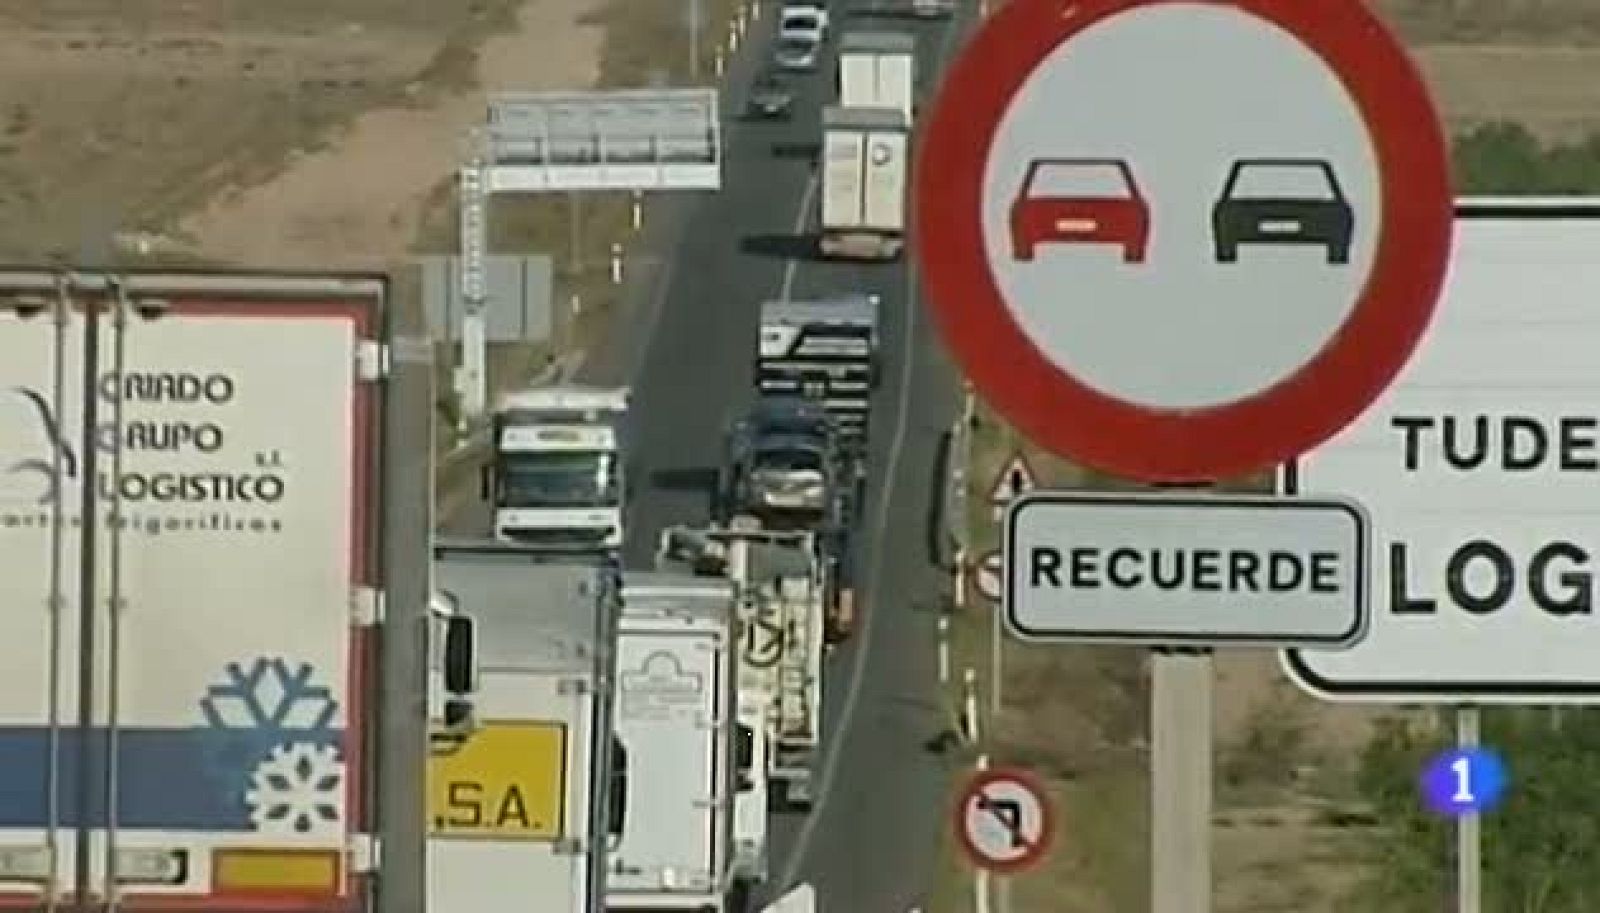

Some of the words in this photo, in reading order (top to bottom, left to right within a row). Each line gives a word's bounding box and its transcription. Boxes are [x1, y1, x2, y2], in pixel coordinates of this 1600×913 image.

[101, 373, 233, 402] CRIADO
[1391, 414, 1600, 472] TUDE
[99, 473, 284, 502] LOGISTICO
[1030, 547, 1340, 592] RECUERDE
[1389, 539, 1592, 617] LOG
